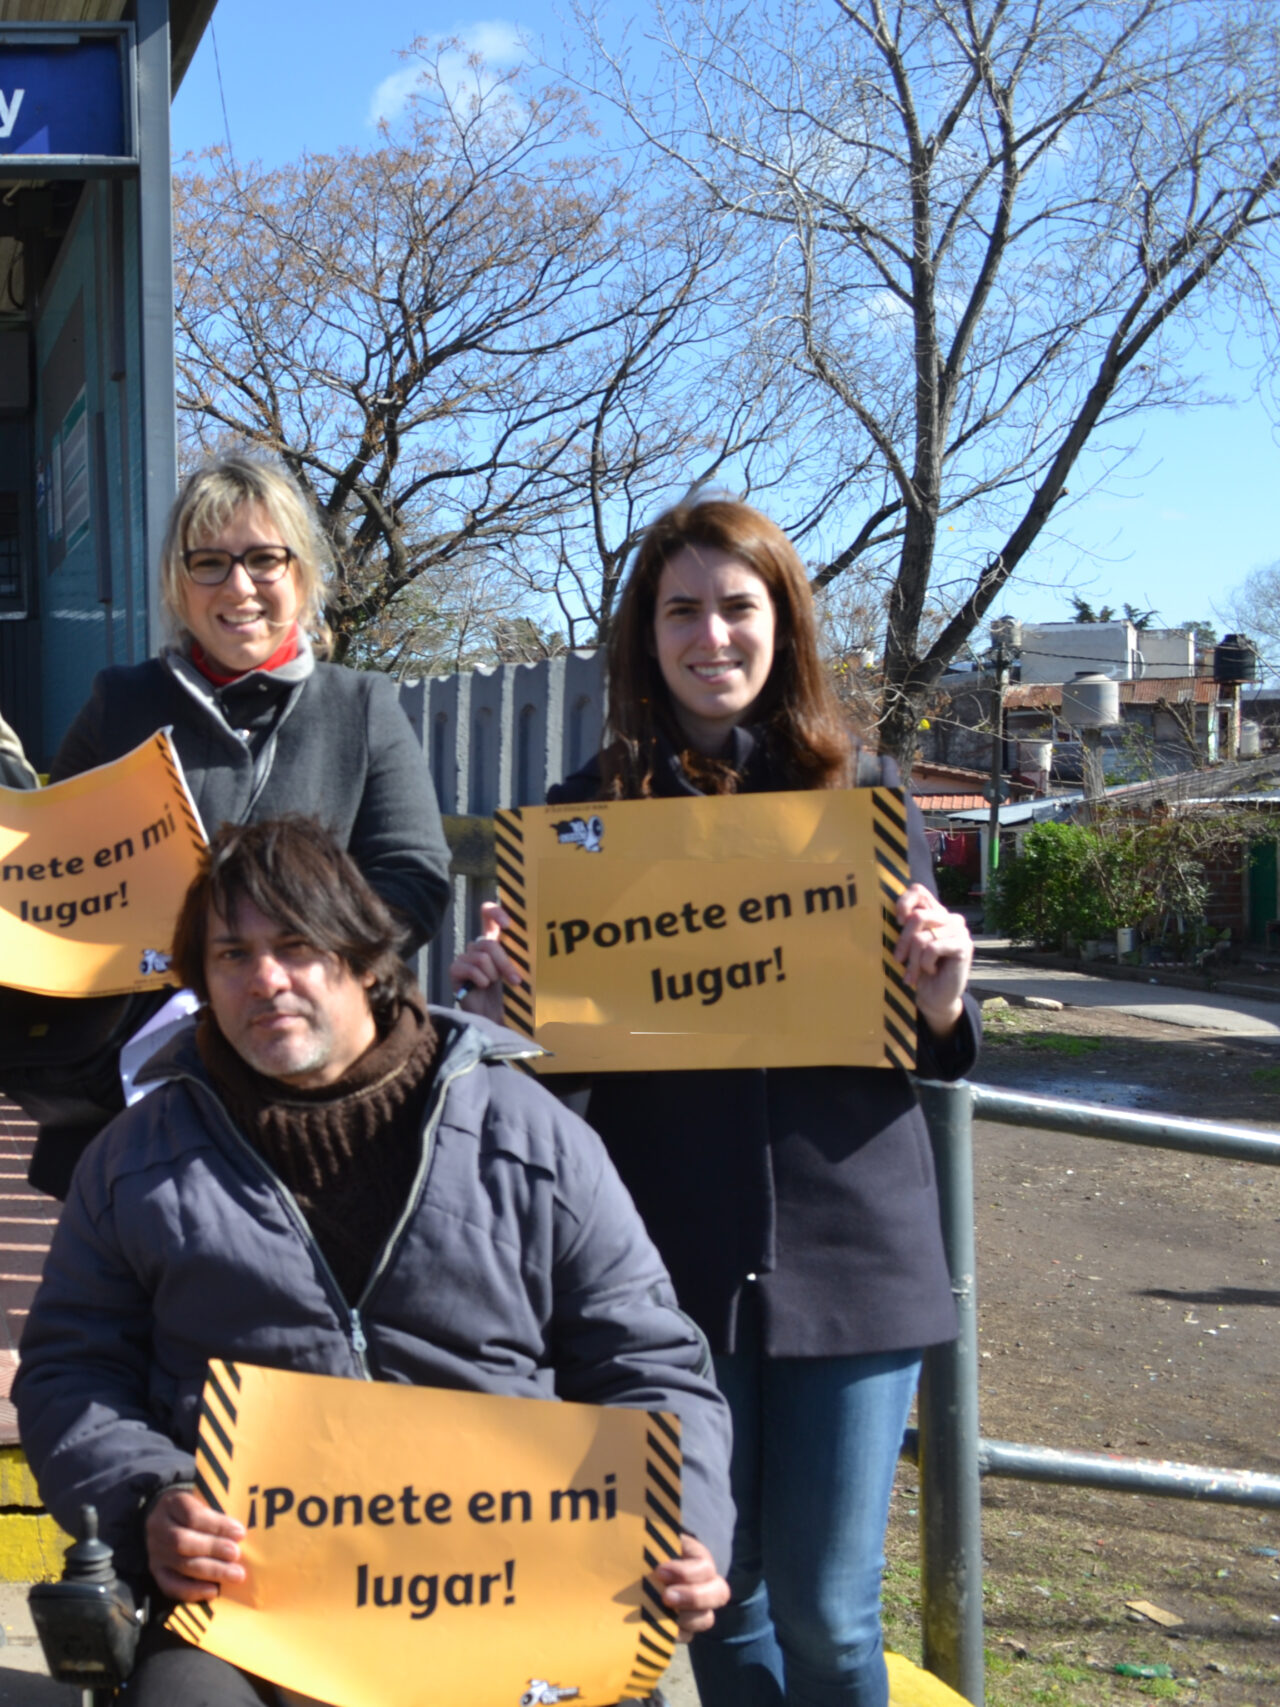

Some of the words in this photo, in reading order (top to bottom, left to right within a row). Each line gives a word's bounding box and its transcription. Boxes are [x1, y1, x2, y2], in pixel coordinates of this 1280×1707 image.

[94, 838, 134, 868] en
[142, 803, 176, 851] mi
[20, 881, 128, 928] lugar!
[546, 903, 726, 958] ¡Ponete
[739, 888, 792, 924] en
[804, 874, 858, 914] mi
[651, 947, 787, 1006] lugar!
[247, 1485, 452, 1530] ¡Ponete
[469, 1489, 532, 1524] en
[550, 1474, 617, 1522] mi
[356, 1560, 516, 1620] lugar!
